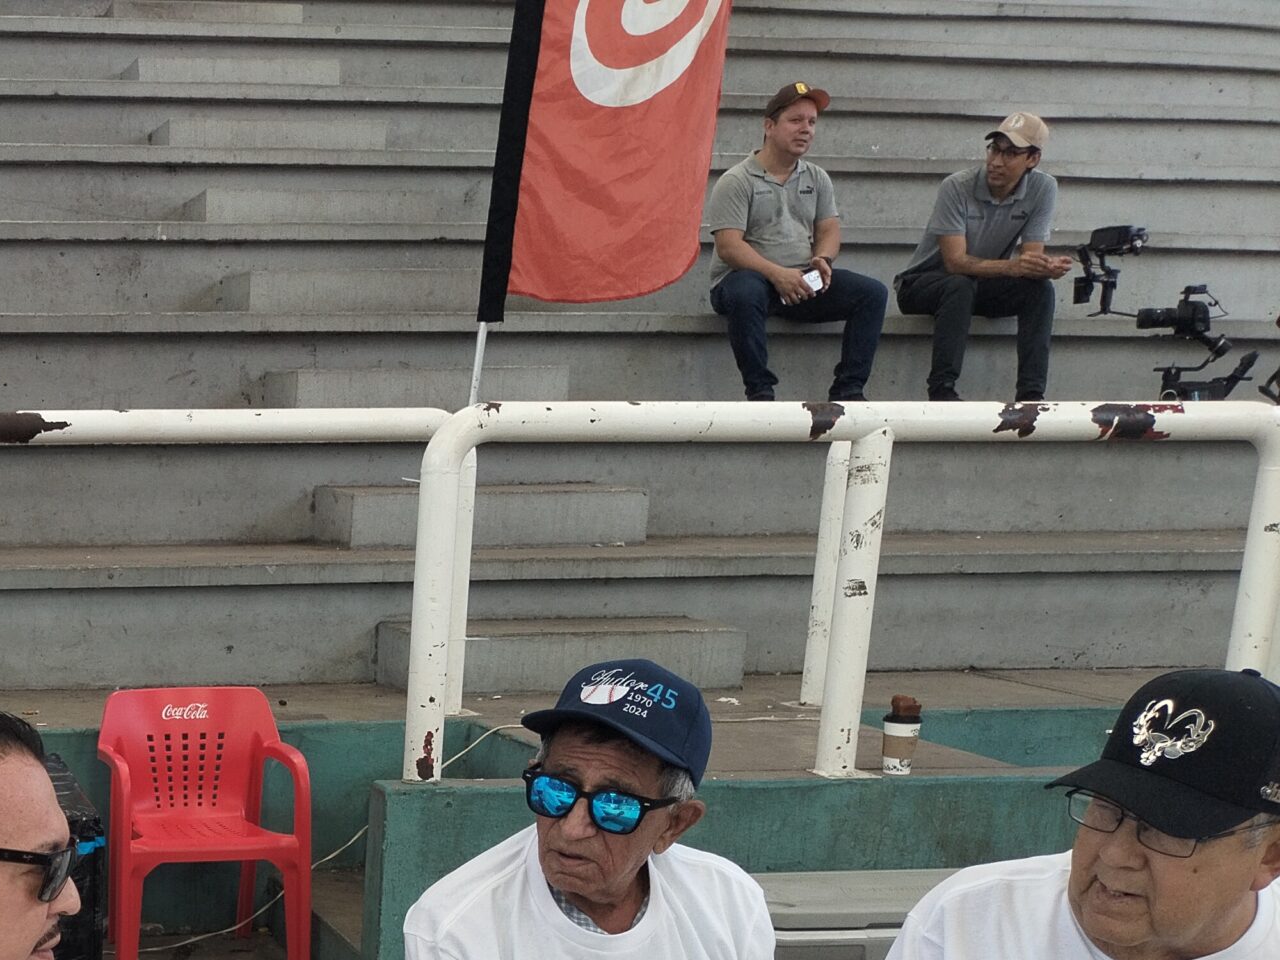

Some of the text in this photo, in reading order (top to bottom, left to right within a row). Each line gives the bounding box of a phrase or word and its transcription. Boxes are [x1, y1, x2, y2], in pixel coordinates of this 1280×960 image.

[627, 692, 653, 708] 1970
[647, 684, 678, 709] 45
[161, 702, 209, 720] Coca-Cola
[623, 703, 648, 718] 2024
